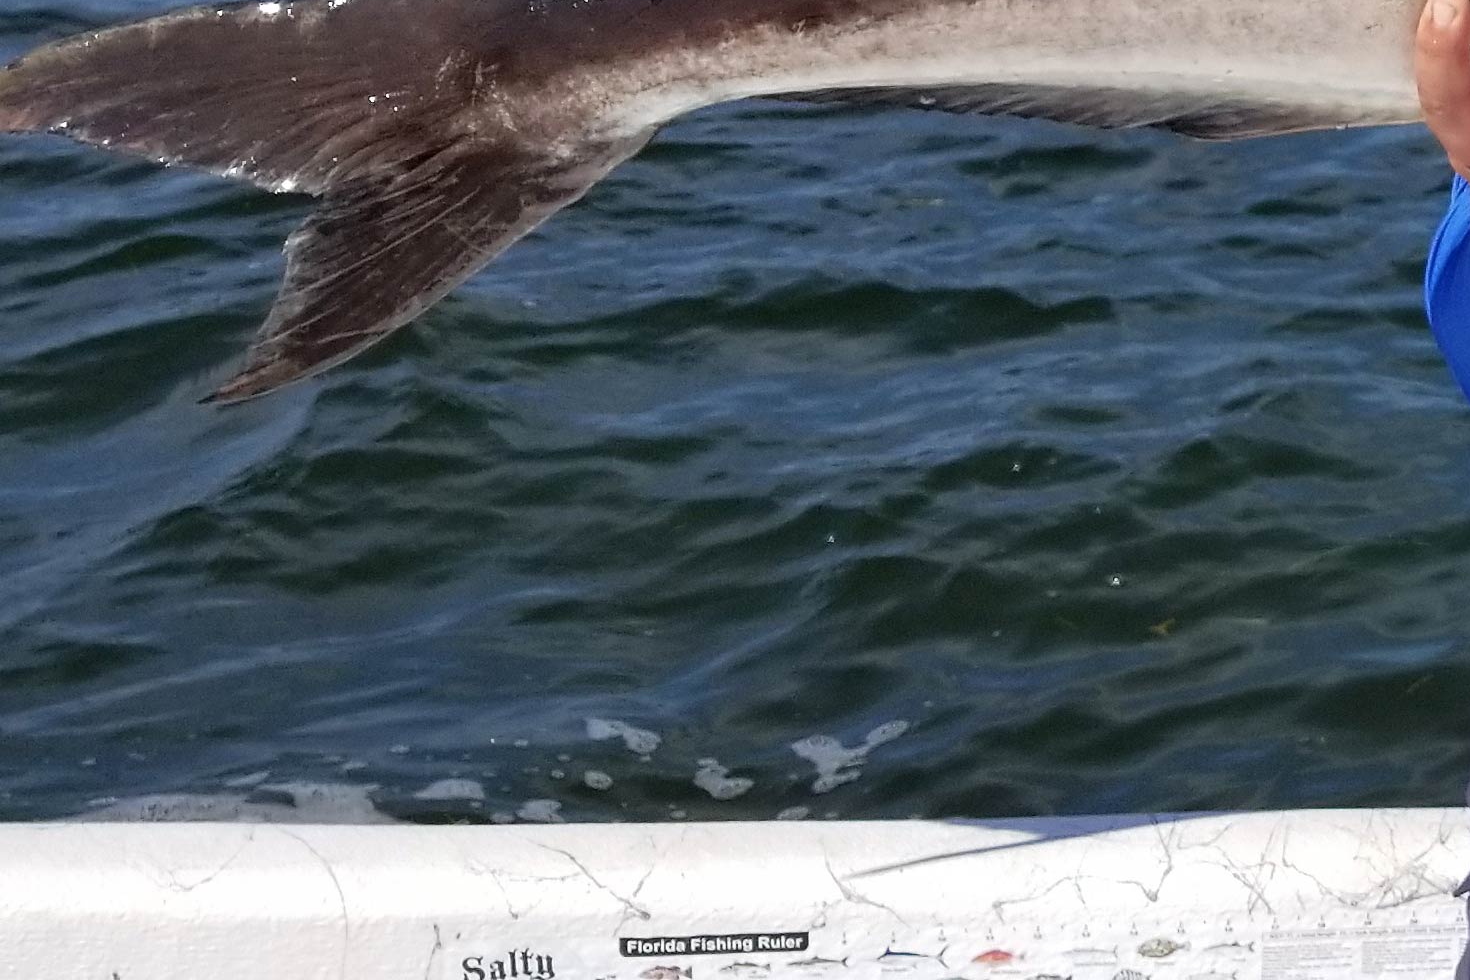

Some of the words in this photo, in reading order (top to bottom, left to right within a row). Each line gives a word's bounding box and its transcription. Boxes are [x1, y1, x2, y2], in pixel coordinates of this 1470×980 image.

[626, 939, 686, 955] Florida
[690, 936, 753, 953] Fishing
[757, 935, 805, 950] Ruler
[461, 947, 556, 980] Salty
